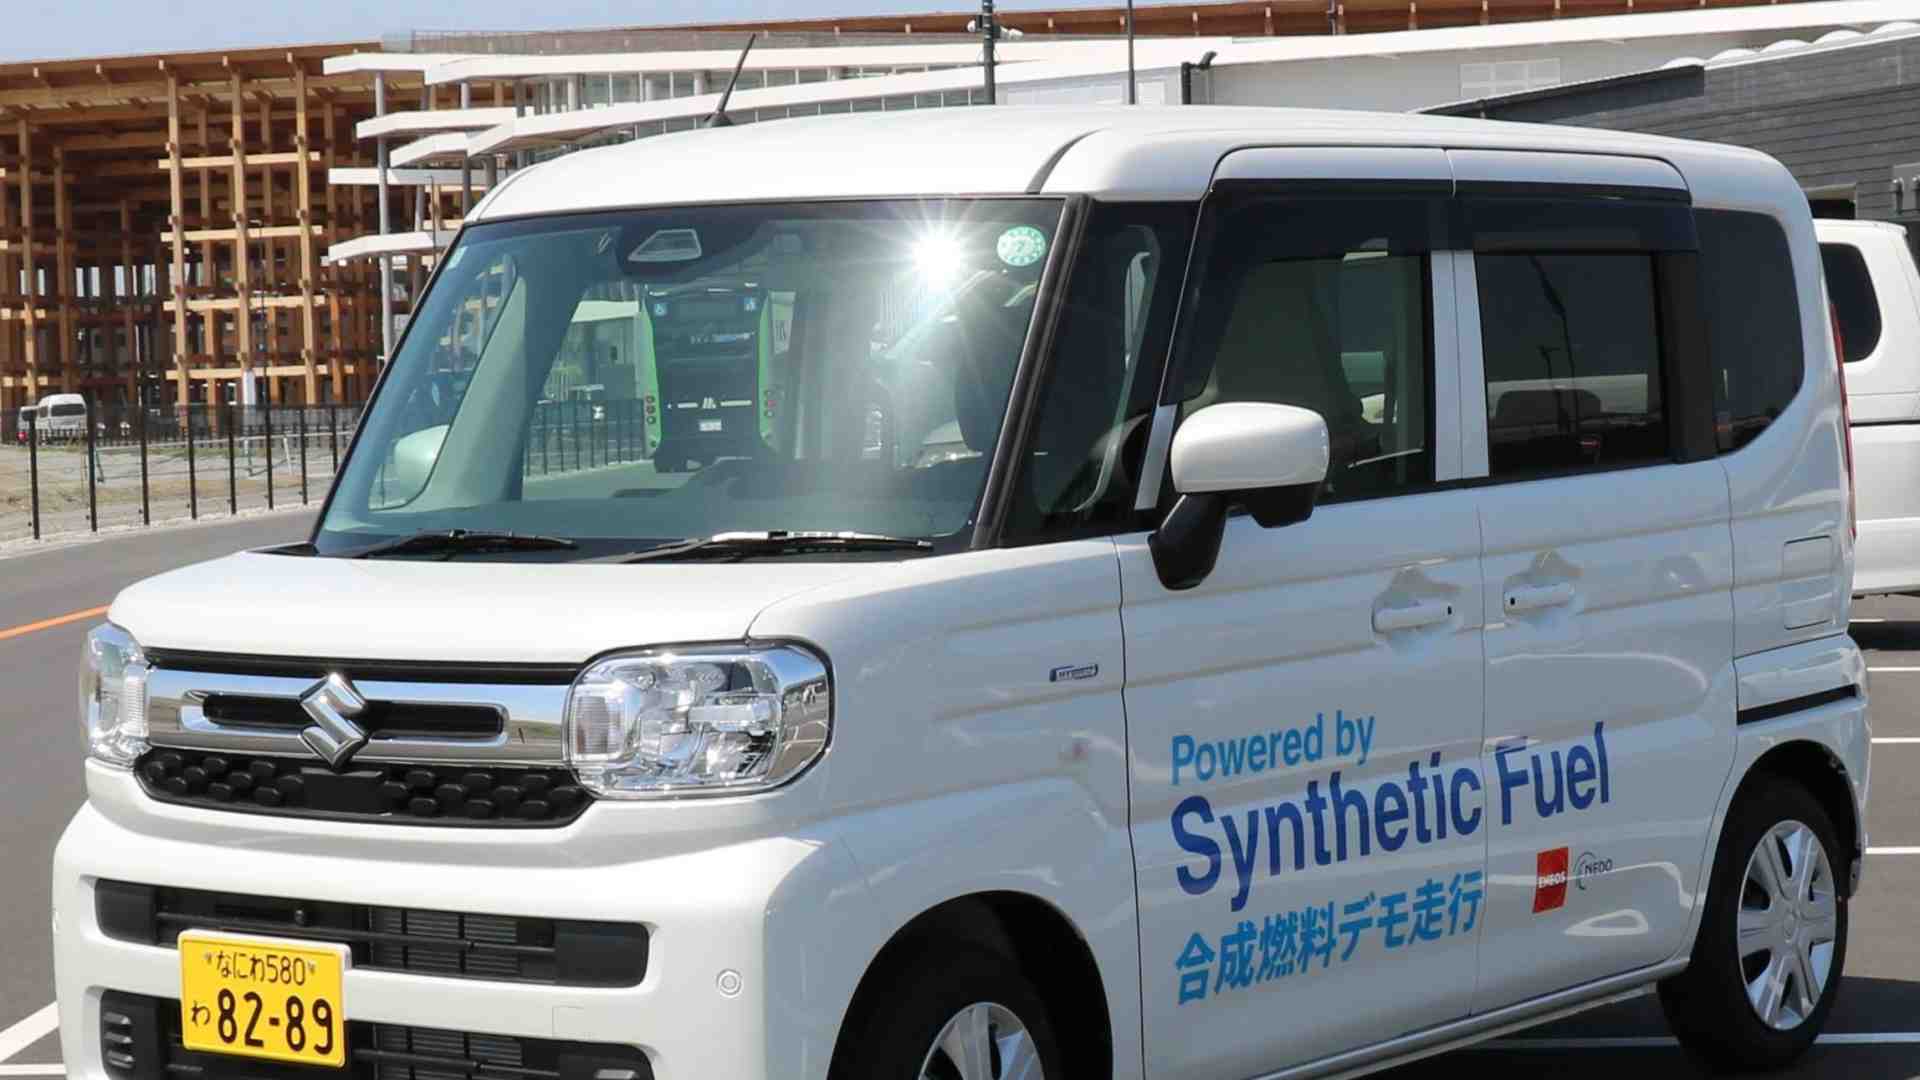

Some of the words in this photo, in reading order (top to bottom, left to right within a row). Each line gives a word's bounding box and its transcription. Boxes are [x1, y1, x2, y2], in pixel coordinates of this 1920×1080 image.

[1171, 712, 1323, 785] Powered
[1336, 710, 1374, 765] by
[1171, 751, 1481, 912] Synthetic
[1496, 721, 1609, 825] Fuel
[1538, 871, 1566, 889] ENEOS
[1175, 870, 1482, 1005] 合成燃料デモ走行
[191, 1001, 211, 1027] わ
[217, 988, 333, 1055] 82-89
